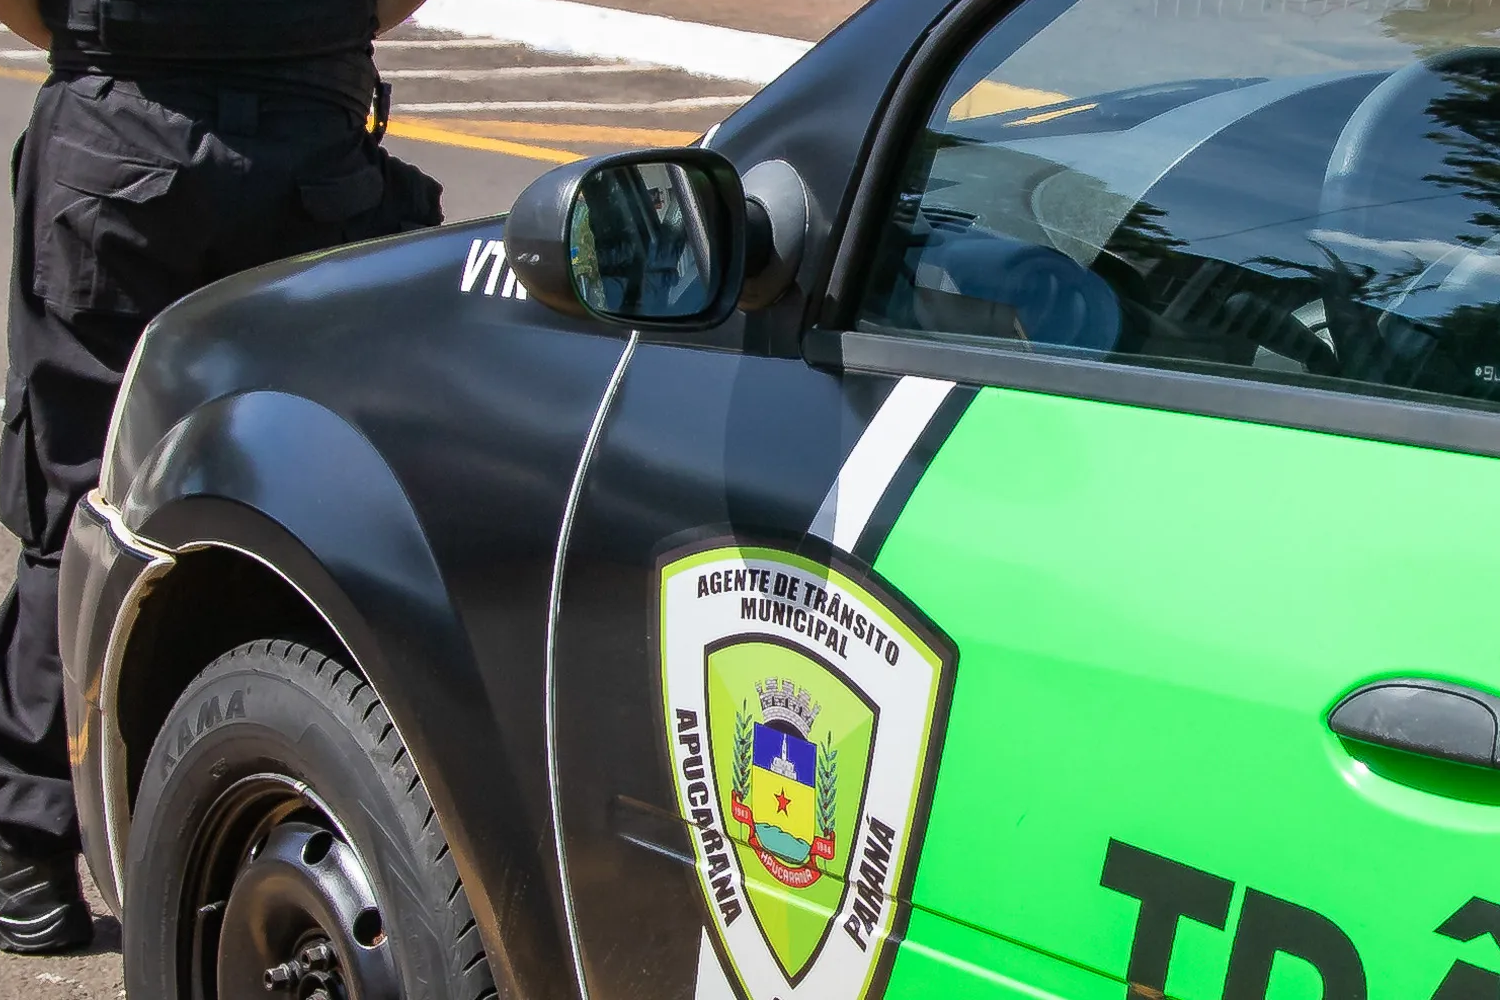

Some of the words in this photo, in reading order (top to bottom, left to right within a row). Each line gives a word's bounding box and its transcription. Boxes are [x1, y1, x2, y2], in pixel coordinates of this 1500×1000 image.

[697, 568, 770, 599] AGENTE
[773, 571, 801, 601] DE
[804, 581, 900, 667] TRÂNSITO
[740, 597, 848, 660] MUNICIPAL
[675, 708, 743, 928] APUCARANA
[842, 813, 896, 953] PARANÁ
